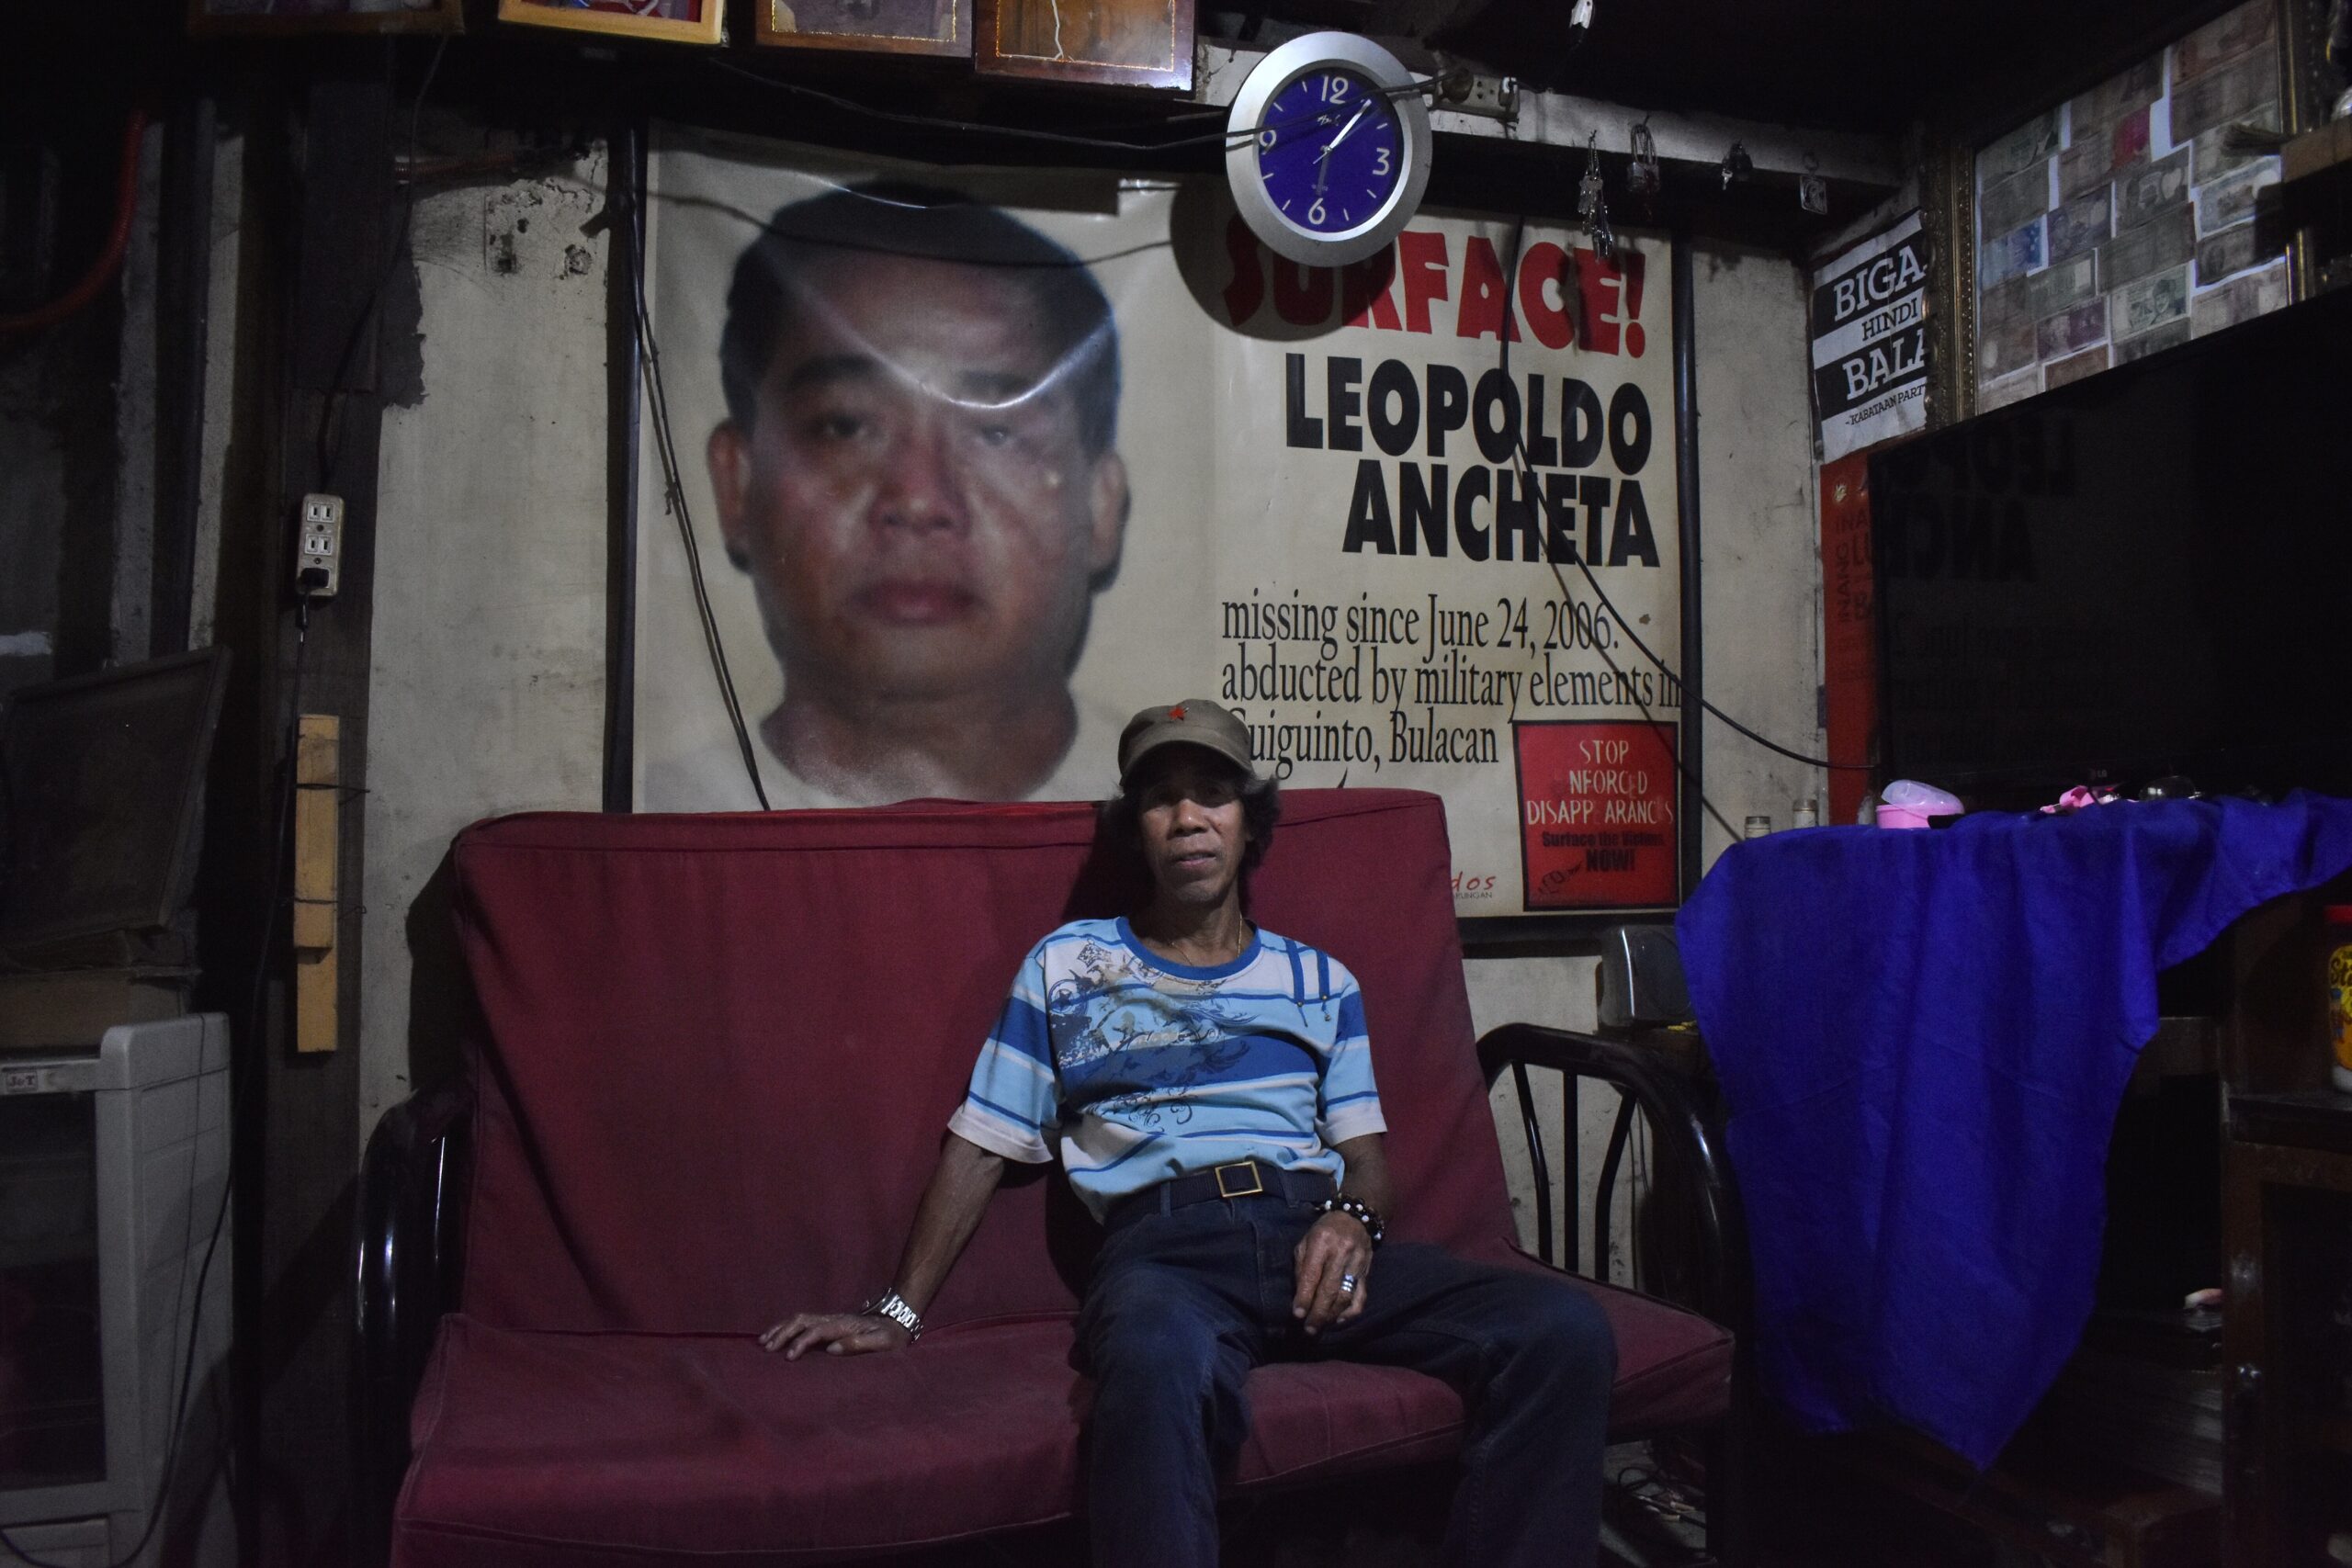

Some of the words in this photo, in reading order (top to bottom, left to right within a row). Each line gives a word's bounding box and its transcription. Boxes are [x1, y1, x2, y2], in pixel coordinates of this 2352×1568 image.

[1321, 75, 1349, 104] 12
[1259, 130, 1277, 155] 9
[1373, 147, 1390, 175] 3
[1308, 197, 1326, 224] 6
[1223, 213, 1645, 358] SURFACE!
[1834, 245, 1928, 321] BIGA
[1862, 299, 1918, 342] HINDI
[1286, 353, 1652, 476] LEOPOLDO
[1897, 383, 1926, 404] PART
[1341, 459, 1661, 568] ANCHETA
[1222, 588, 1339, 660] missing
[1346, 592, 1420, 645] since
[1422, 593, 1489, 663] June
[1497, 597, 1536, 657] 24,
[1544, 602, 1620, 651] 2006.
[1222, 642, 1363, 704] abducted
[1373, 645, 1408, 716] by
[1414, 649, 1523, 723] military
[1530, 652, 1653, 707] elements
[1658, 659, 1680, 707] in
[1229, 707, 1381, 781] uiguinto,
[1389, 708, 1499, 763] Bulacan
[1579, 739, 1630, 764] STOP
